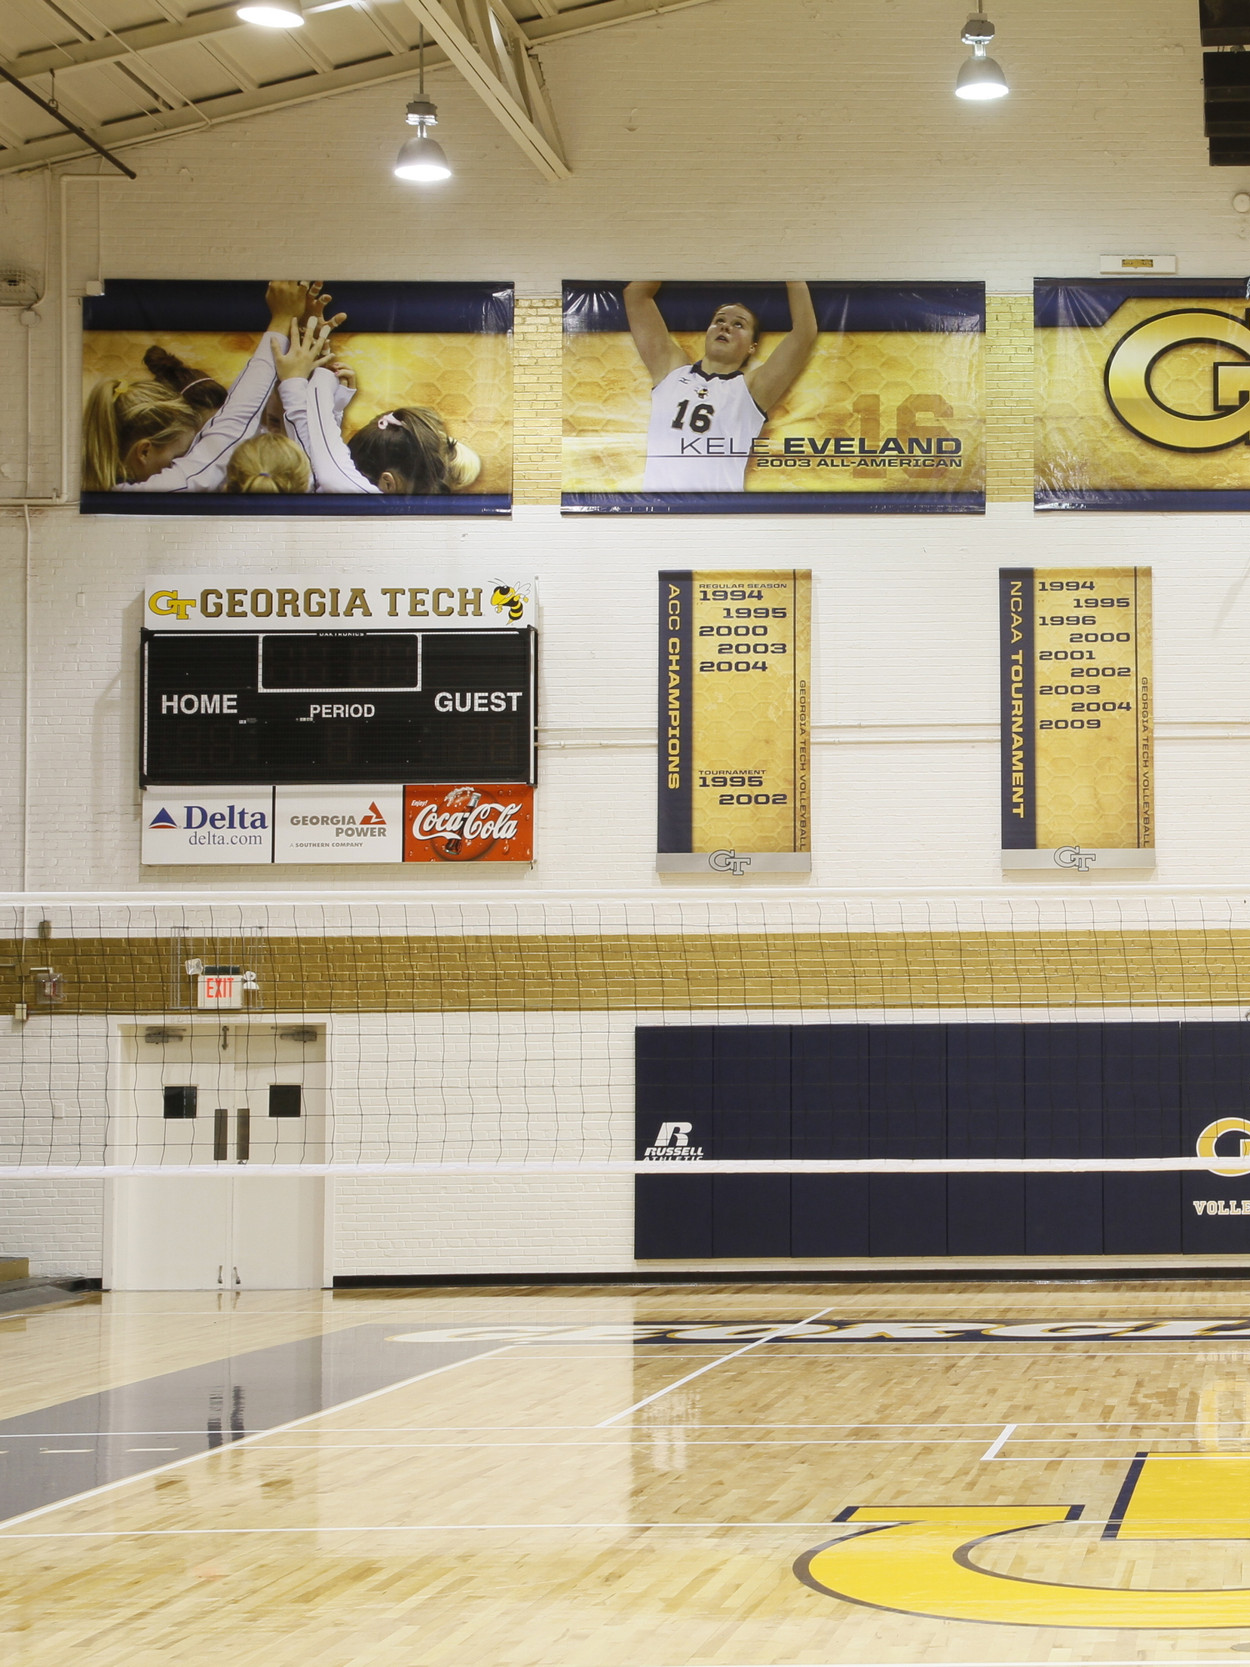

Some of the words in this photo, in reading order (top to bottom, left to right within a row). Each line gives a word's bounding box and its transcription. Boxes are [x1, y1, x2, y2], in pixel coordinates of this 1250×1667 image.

[671, 400, 715, 433] 16
[852, 394, 954, 479] 16
[681, 438, 769, 454] KELE
[784, 437, 962, 455] EVELAND
[756, 458, 811, 468] 2003
[816, 458, 962, 468] ALL-AMERICAN
[1038, 581, 1095, 591] 1994
[201, 588, 373, 617] GEORGIA
[382, 587, 484, 617] TECH
[700, 590, 764, 601] 1994
[148, 589, 197, 620] GT
[668, 583, 681, 631] ACC
[1073, 598, 1130, 608] 1995
[723, 608, 787, 619] 1995
[1010, 581, 1023, 644] NCAA
[1039, 616, 1096, 626] 1996
[699, 625, 768, 636] 2000
[1069, 632, 1130, 643] 2000
[718, 643, 787, 654] 2003
[1039, 650, 1096, 661] 2001
[700, 661, 768, 672] 2004
[1070, 667, 1131, 678] 2002
[1039, 685, 1101, 695] 2003
[161, 694, 238, 714] HOME
[434, 692, 523, 712] GUEST
[799, 680, 807, 735] GEORGIA
[1071, 701, 1132, 712] 2004
[1141, 677, 1149, 733] GEORGIA
[310, 704, 375, 719] PERIOD
[668, 637, 681, 789] CHAMPIONS
[1039, 719, 1101, 729] 2009
[1010, 650, 1025, 819] TOURNAMENT
[699, 776, 763, 788] 1995
[719, 794, 787, 805] 2002
[1142, 770, 1150, 847] VOLLEYBALL
[183, 805, 268, 830] Delta
[290, 815, 357, 826] GEORGIA
[412, 803, 522, 840] Coca-Cola
[188, 831, 263, 845] delta.com
[335, 826, 387, 838] POWER
[708, 849, 751, 876] GT
[1054, 846, 1096, 872] GT
[206, 977, 234, 998] EXIT
[644, 1147, 704, 1156] RUSSELL
